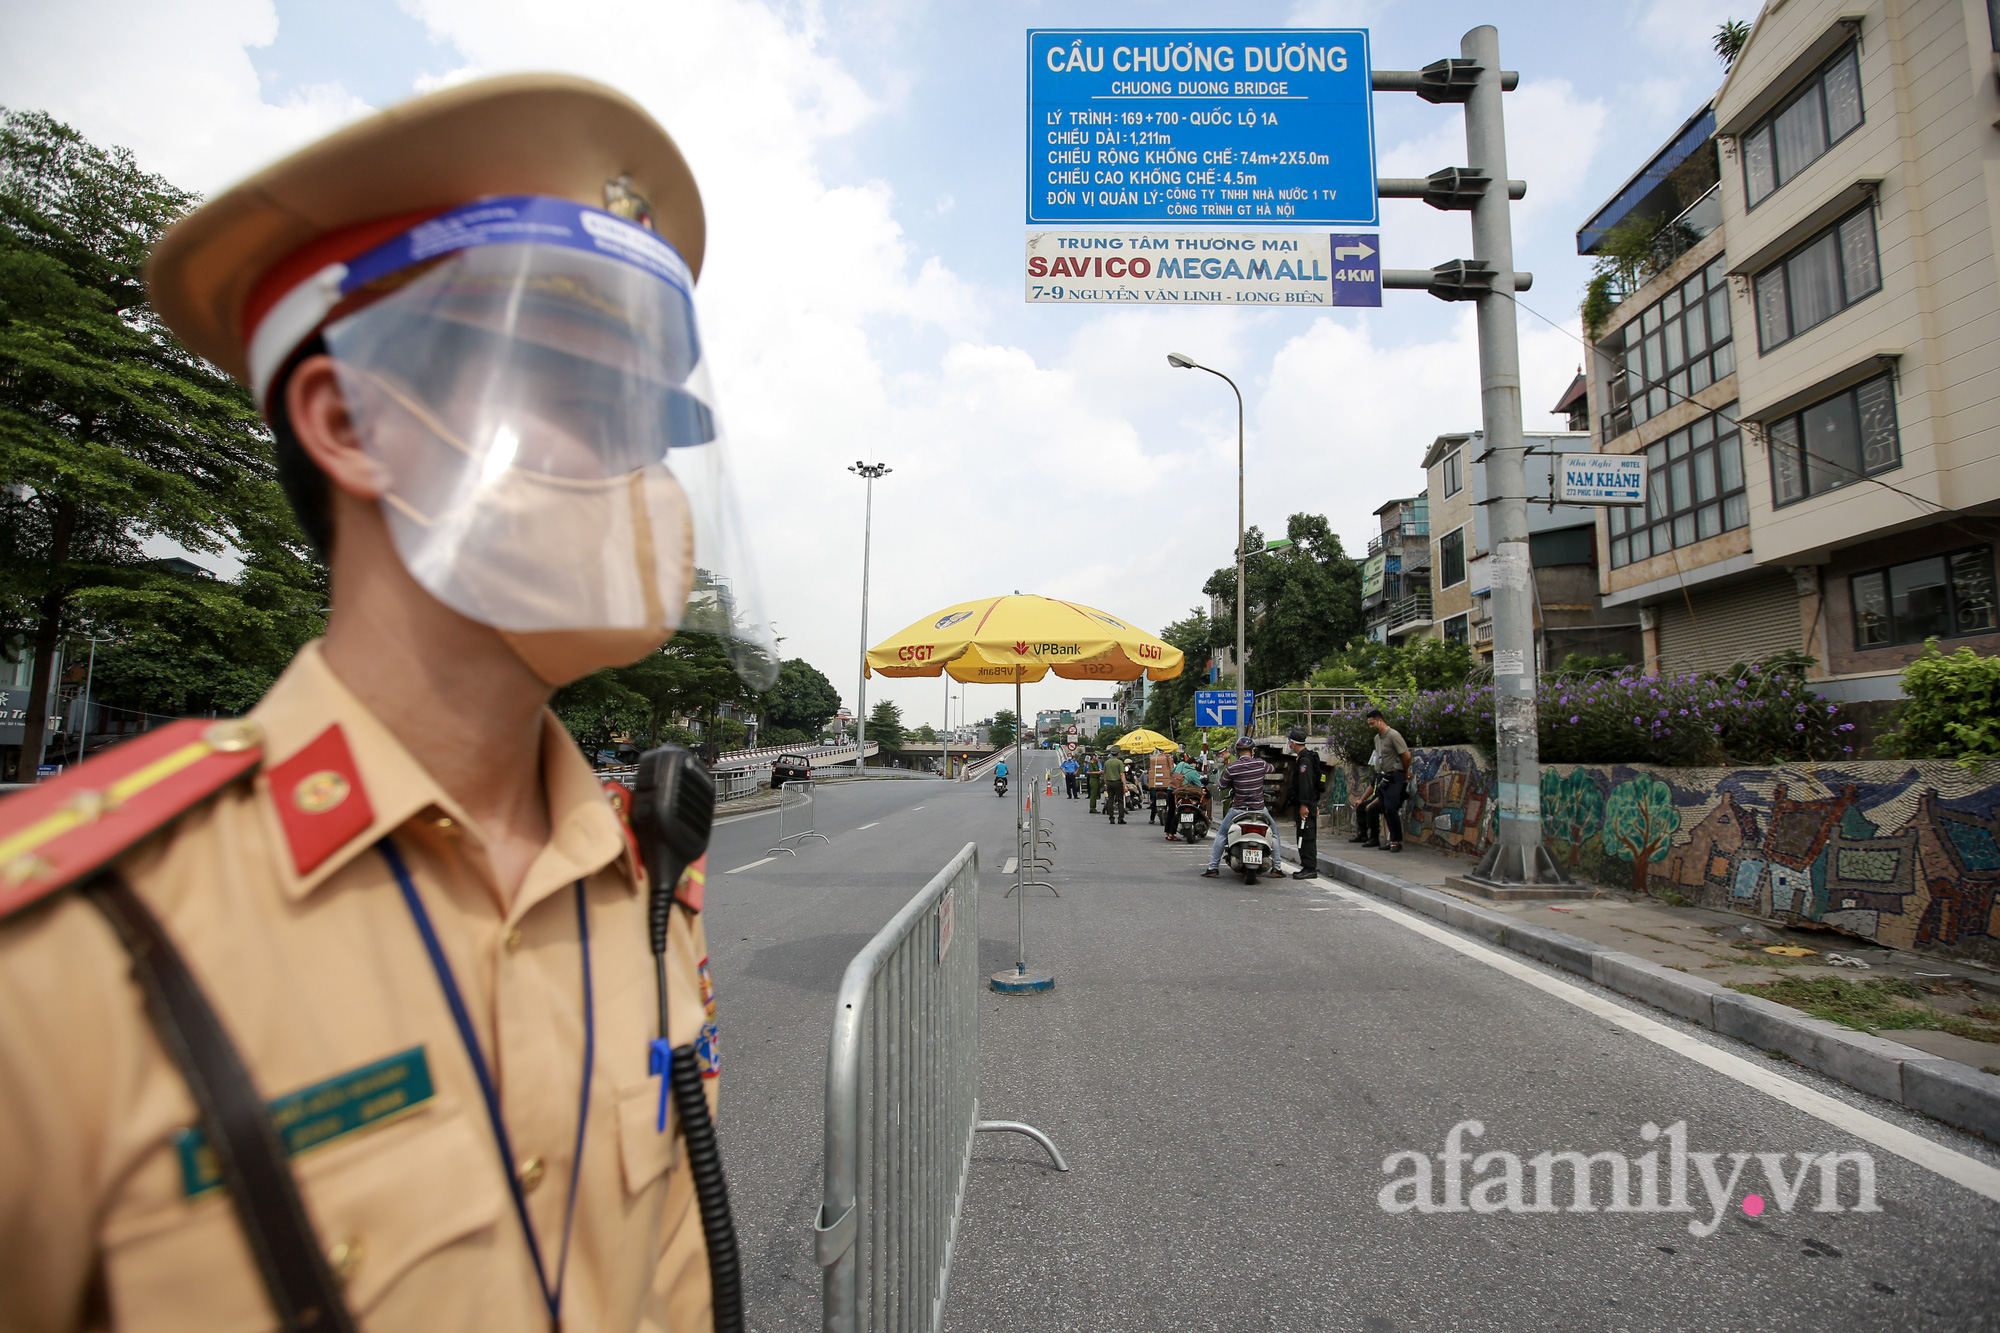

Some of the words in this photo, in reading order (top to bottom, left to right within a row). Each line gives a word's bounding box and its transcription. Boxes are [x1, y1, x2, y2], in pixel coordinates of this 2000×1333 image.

[1047, 39, 1104, 72] CẦU
[1113, 42, 1234, 72] CHƯƠNG
[1245, 42, 1348, 72] DƯƠNG
[1111, 81, 1172, 95] CHUONG
[1178, 81, 1229, 95] DUONG
[1234, 81, 1289, 95] BRIDGE
[1047, 109, 1062, 125] LÝ
[1190, 106, 1232, 126] QUỐC
[1238, 108, 1256, 128] LỘ
[1261, 112, 1278, 125] 1A
[1047, 128, 1089, 145] CHIỀU
[1130, 132, 1171, 146] 1,211m
[1048, 147, 1091, 164] CHIỀU
[1098, 147, 1139, 166] RỘNG
[1145, 147, 1198, 164] KHỐNG
[1048, 167, 1090, 184] CHIỀU
[1094, 171, 1124, 185] CAO
[1130, 167, 1181, 185] KHỐNG
[1223, 171, 1257, 185] 4.5m
[1046, 189, 1076, 205] ĐƠN
[1082, 191, 1095, 206] VỊ
[1099, 187, 1138, 205] QUẢN
[1166, 187, 1197, 200] CÔNG
[1201, 189, 1215, 200] TY
[1221, 189, 1248, 200] TNHH
[1252, 187, 1275, 200] NHÀ
[1279, 186, 1308, 200] NƯỚC
[1312, 190, 1318, 200] 1
[1323, 190, 1337, 200] TV
[1167, 202, 1198, 215] CÔNG
[1201, 202, 1233, 215] TRÌNH
[1237, 205, 1252, 215] GT
[1256, 203, 1272, 215] HÀ
[1276, 203, 1295, 217] NỘI
[1058, 238, 1124, 249] TRUNG
[1129, 236, 1169, 250] TÂM
[1175, 237, 1256, 251] THƯƠNG
[1262, 240, 1298, 254] MẠI
[1028, 256, 1152, 278] SAVICO
[1156, 258, 1328, 281] MEGAMALL
[1335, 269, 1375, 282] 4KM
[1032, 286, 1064, 300] 7-9
[1068, 285, 1139, 300] NGUYỄN
[1144, 288, 1180, 300] VĂN
[1184, 291, 1222, 301] LINH
[1236, 291, 1283, 302] LONG
[1285, 290, 1324, 303] BIÊN
[1567, 471, 1594, 486] NAM
[1597, 469, 1640, 488] KHÁNH
[898, 645, 934, 661] CSGT
[1033, 643, 1081, 655] VPBank
[1139, 643, 1163, 660] CSGT
